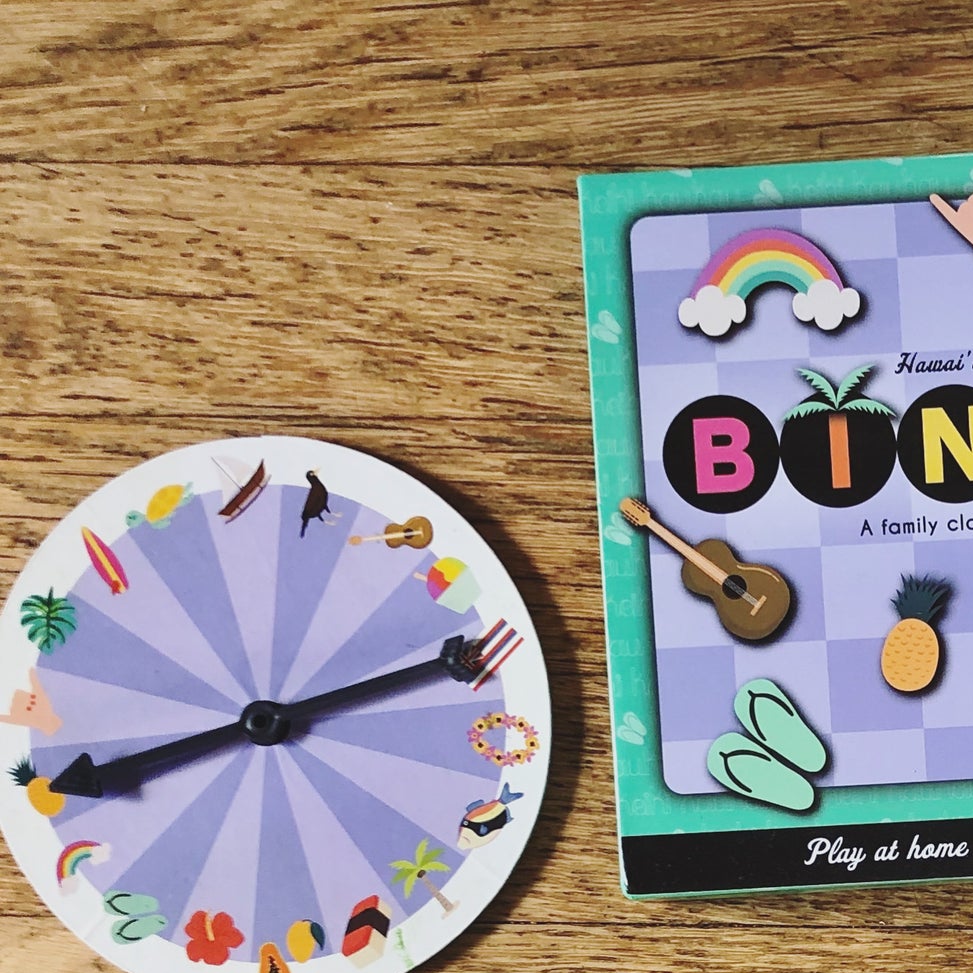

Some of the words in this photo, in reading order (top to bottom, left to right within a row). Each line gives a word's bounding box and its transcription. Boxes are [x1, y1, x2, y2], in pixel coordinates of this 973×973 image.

[860, 518, 874, 538] A
[881, 517, 938, 536] family
[803, 835, 867, 872] Play
[873, 838, 900, 863] at
[905, 834, 970, 861] home
